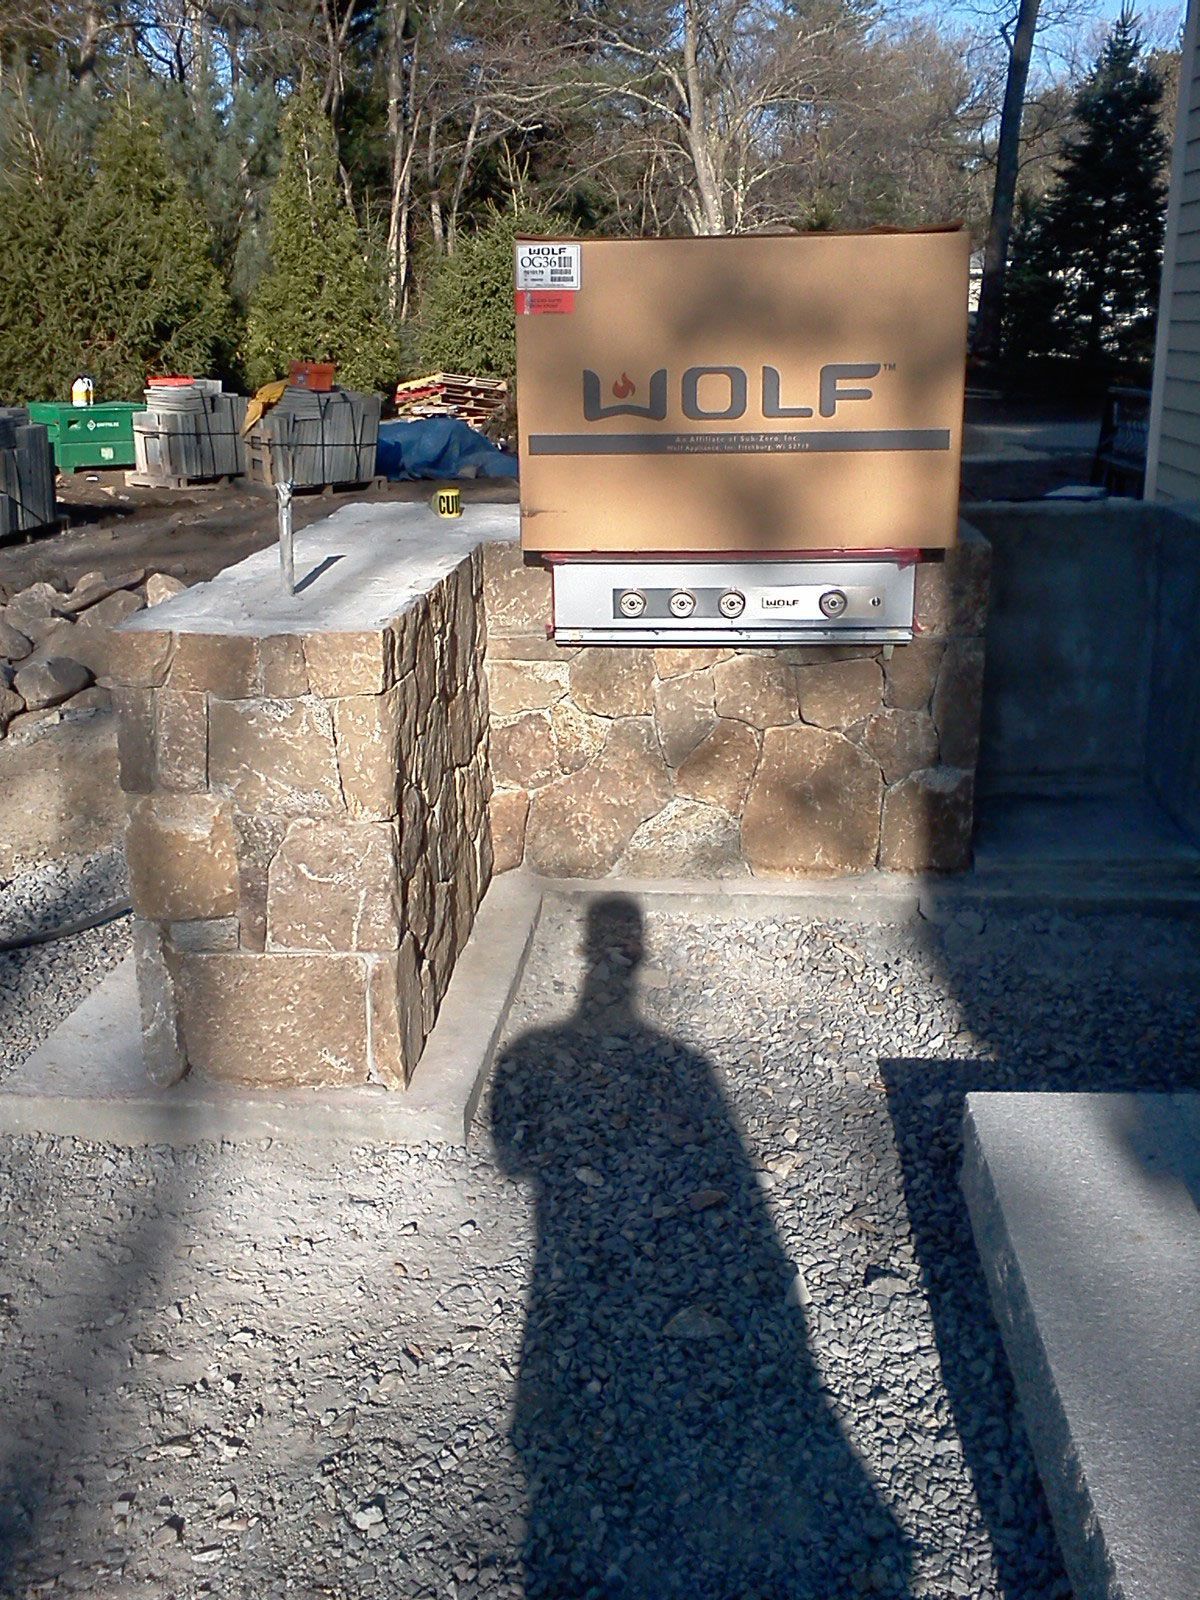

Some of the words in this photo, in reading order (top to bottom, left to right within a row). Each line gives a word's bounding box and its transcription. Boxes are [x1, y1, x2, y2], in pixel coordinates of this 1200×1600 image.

[528, 247, 567, 256] WOLF
[520, 255, 557, 268] OG36
[582, 363, 881, 422] WOLF
[766, 599, 800, 607] WOLF
